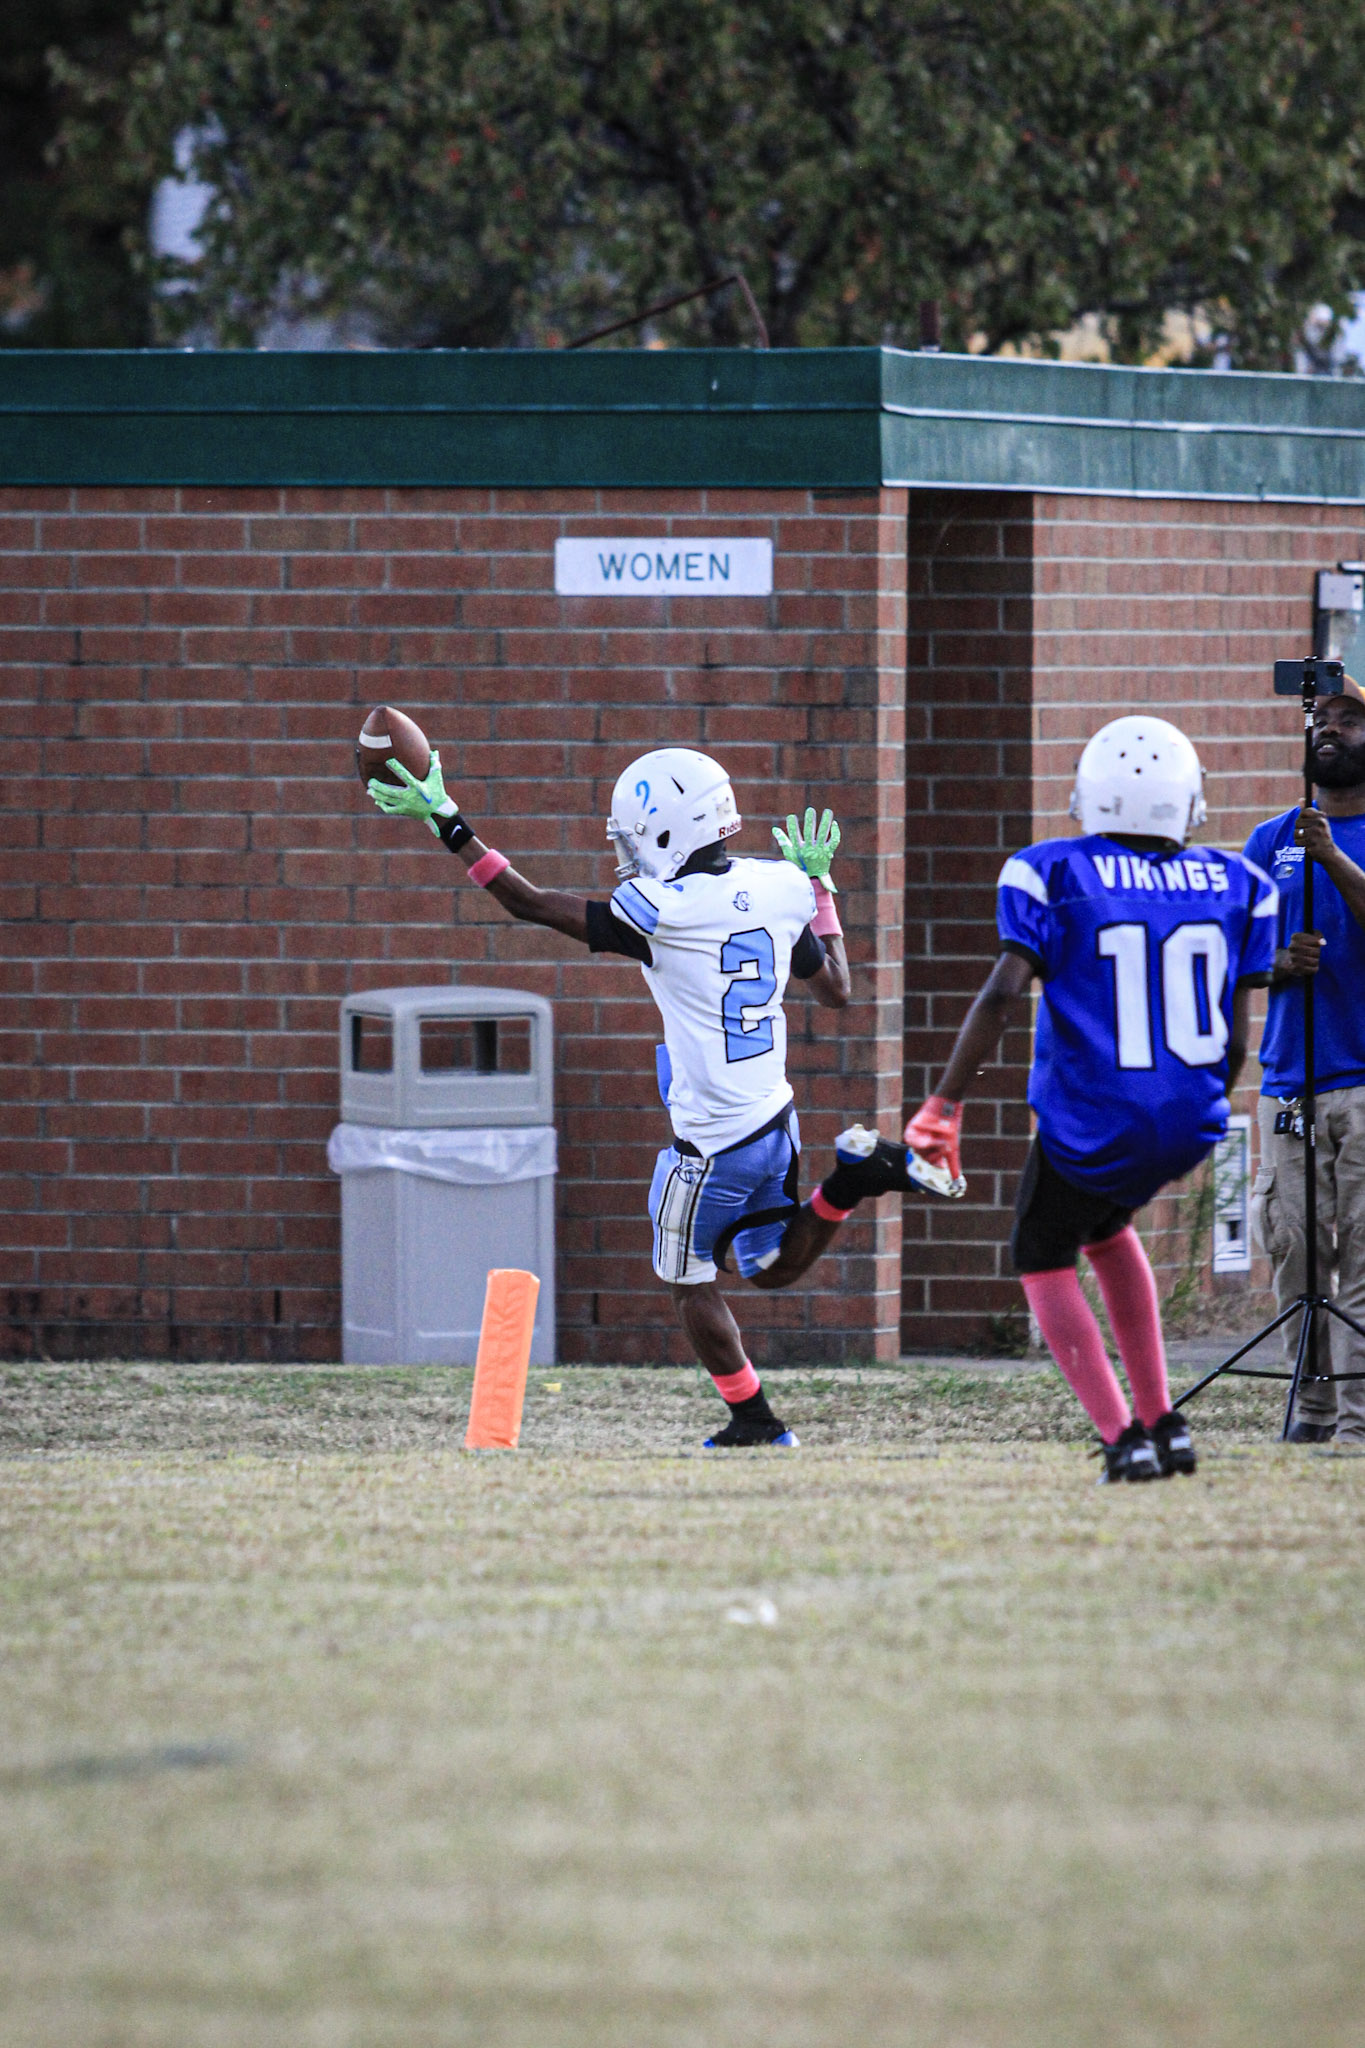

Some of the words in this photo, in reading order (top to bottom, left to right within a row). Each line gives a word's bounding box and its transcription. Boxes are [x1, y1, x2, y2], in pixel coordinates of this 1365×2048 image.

[598, 553, 730, 581] WOMEN
[1092, 855, 1230, 892] VIKINGS
[720, 927, 777, 1064] 2
[1097, 921, 1230, 1071] 10
